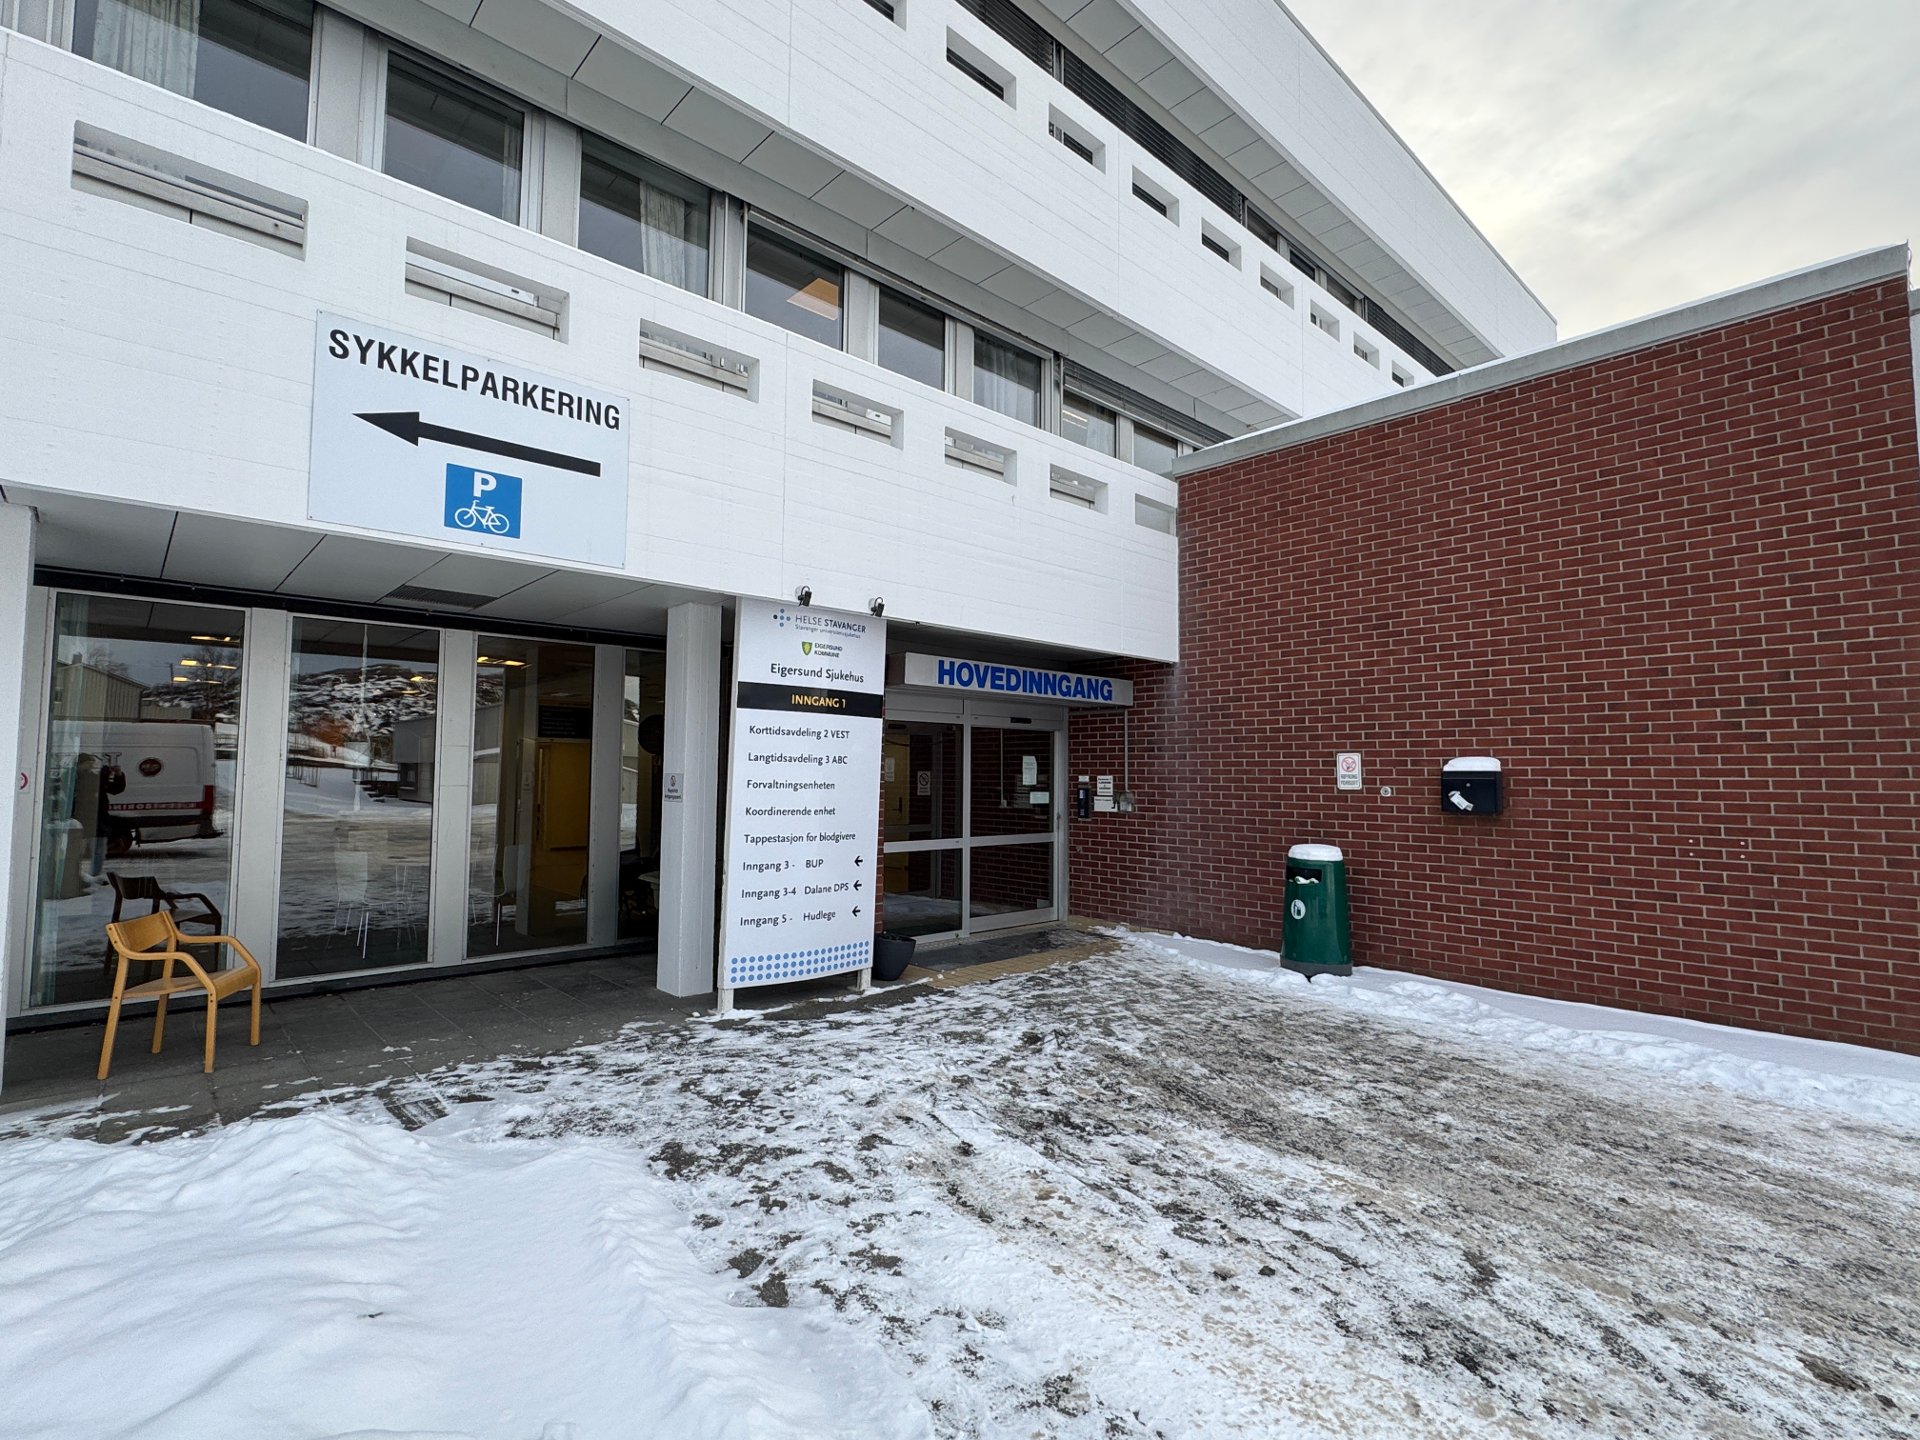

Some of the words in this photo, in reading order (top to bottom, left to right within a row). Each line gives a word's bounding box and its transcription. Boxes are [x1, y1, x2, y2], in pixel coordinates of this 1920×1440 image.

[328, 329, 620, 430] SYKKELPARKERING
[472, 471, 497, 497] P
[795, 614, 822, 626] HELSE
[824, 618, 866, 633] STAVANGER
[795, 624, 818, 633] Stavanger
[814, 642, 843, 652] EIGERSUND
[814, 650, 839, 658] KOMMUNE
[770, 663, 823, 678] Eigersund
[825, 668, 864, 683] Sjukehus
[937, 659, 1113, 701] HOVEDINNGANG
[791, 694, 839, 708] INNGANG
[841, 698, 846, 709] 1
[749, 725, 822, 740] Korttidsavdeling
[823, 729, 829, 738] 2
[831, 730, 850, 739] VEST
[748, 752, 824, 766] Langtidsavdeling
[825, 755, 830, 764] 3
[831, 755, 848, 765] ABC
[746, 779, 836, 792] Forvaltningsenheten
[745, 807, 812, 816] Koordinerende
[813, 807, 836, 816] enhet
[744, 834, 804, 845] Tappestasjon
[806, 833, 818, 842] for
[819, 832, 856, 844] blodgivere
[742, 861, 782, 873] Inngang
[783, 860, 789, 869] 3
[805, 859, 824, 868] BUP
[741, 888, 780, 900] Inngang
[782, 887, 797, 897] 3-4
[804, 885, 832, 895] Dalane
[833, 882, 850, 892] DPS
[740, 916, 779, 927] Inngang
[781, 914, 787, 923] 5
[803, 910, 836, 922] Hudlege
